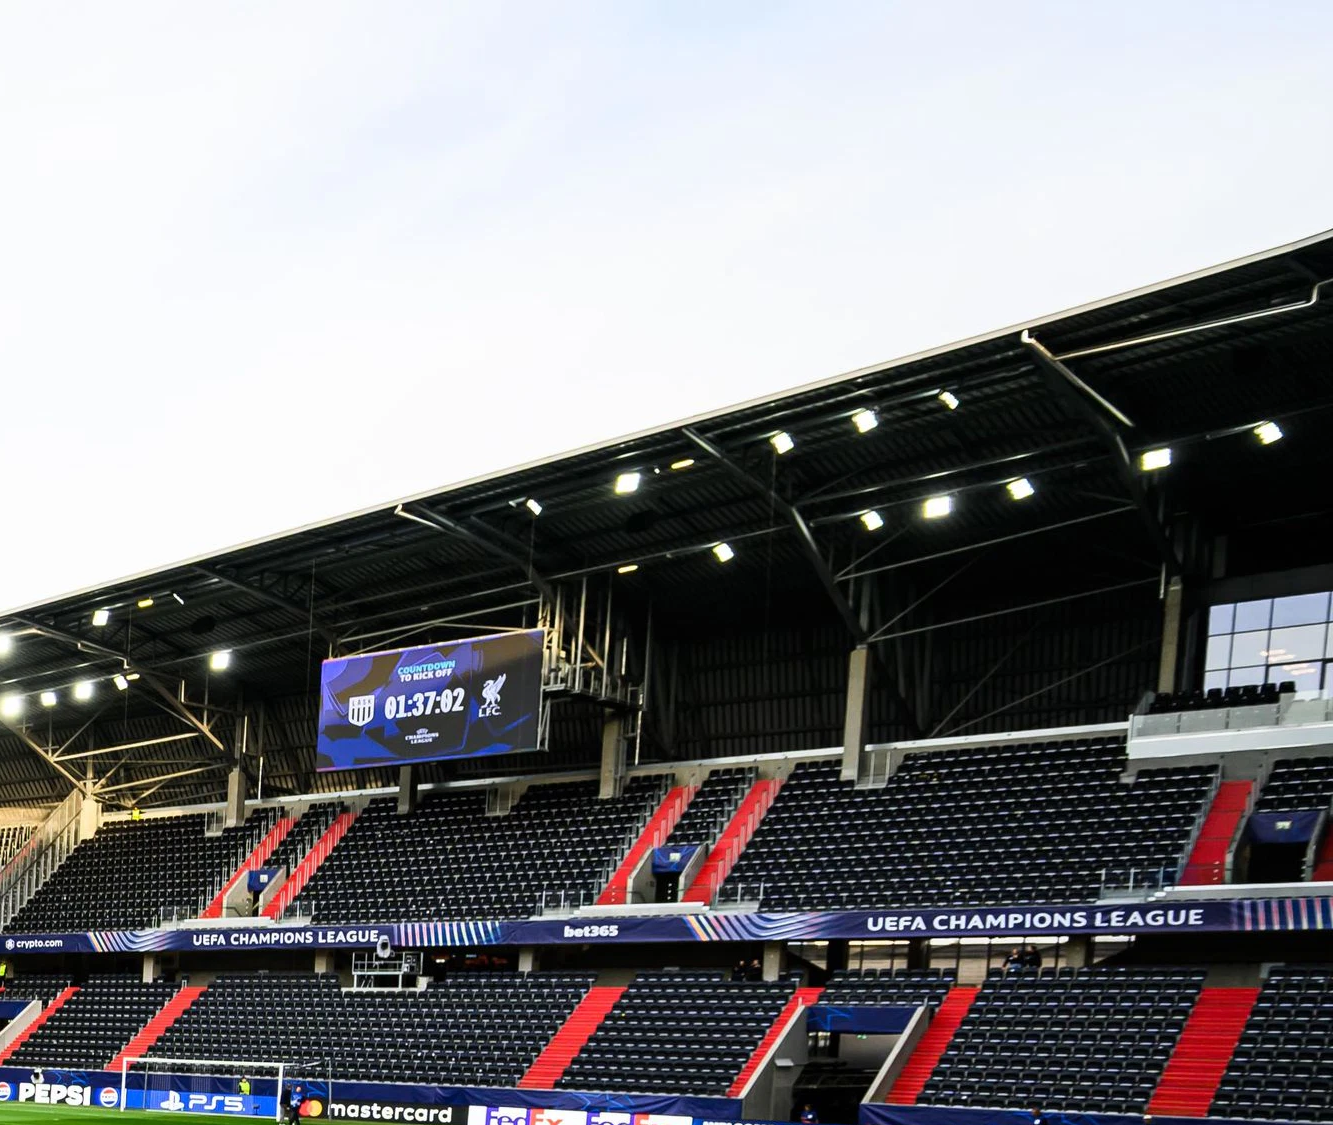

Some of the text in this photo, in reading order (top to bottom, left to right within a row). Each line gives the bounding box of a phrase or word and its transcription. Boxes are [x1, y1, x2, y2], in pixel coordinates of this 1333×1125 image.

[398, 660, 455, 675] COUNTDOWN
[400, 668, 453, 682] TO KICK OFF
[385, 688, 465, 719] 01:37:02
[867, 909, 1203, 932] UEFA CHAMPIONS LEAGUE
[193, 929, 379, 946] UEFA CHAMPIONS LEAGUE
[564, 925, 619, 938] bet365
[16, 939, 63, 949] crypto.com
[18, 1082, 91, 1106] PEPSI
[327, 1103, 452, 1123] mastercard
